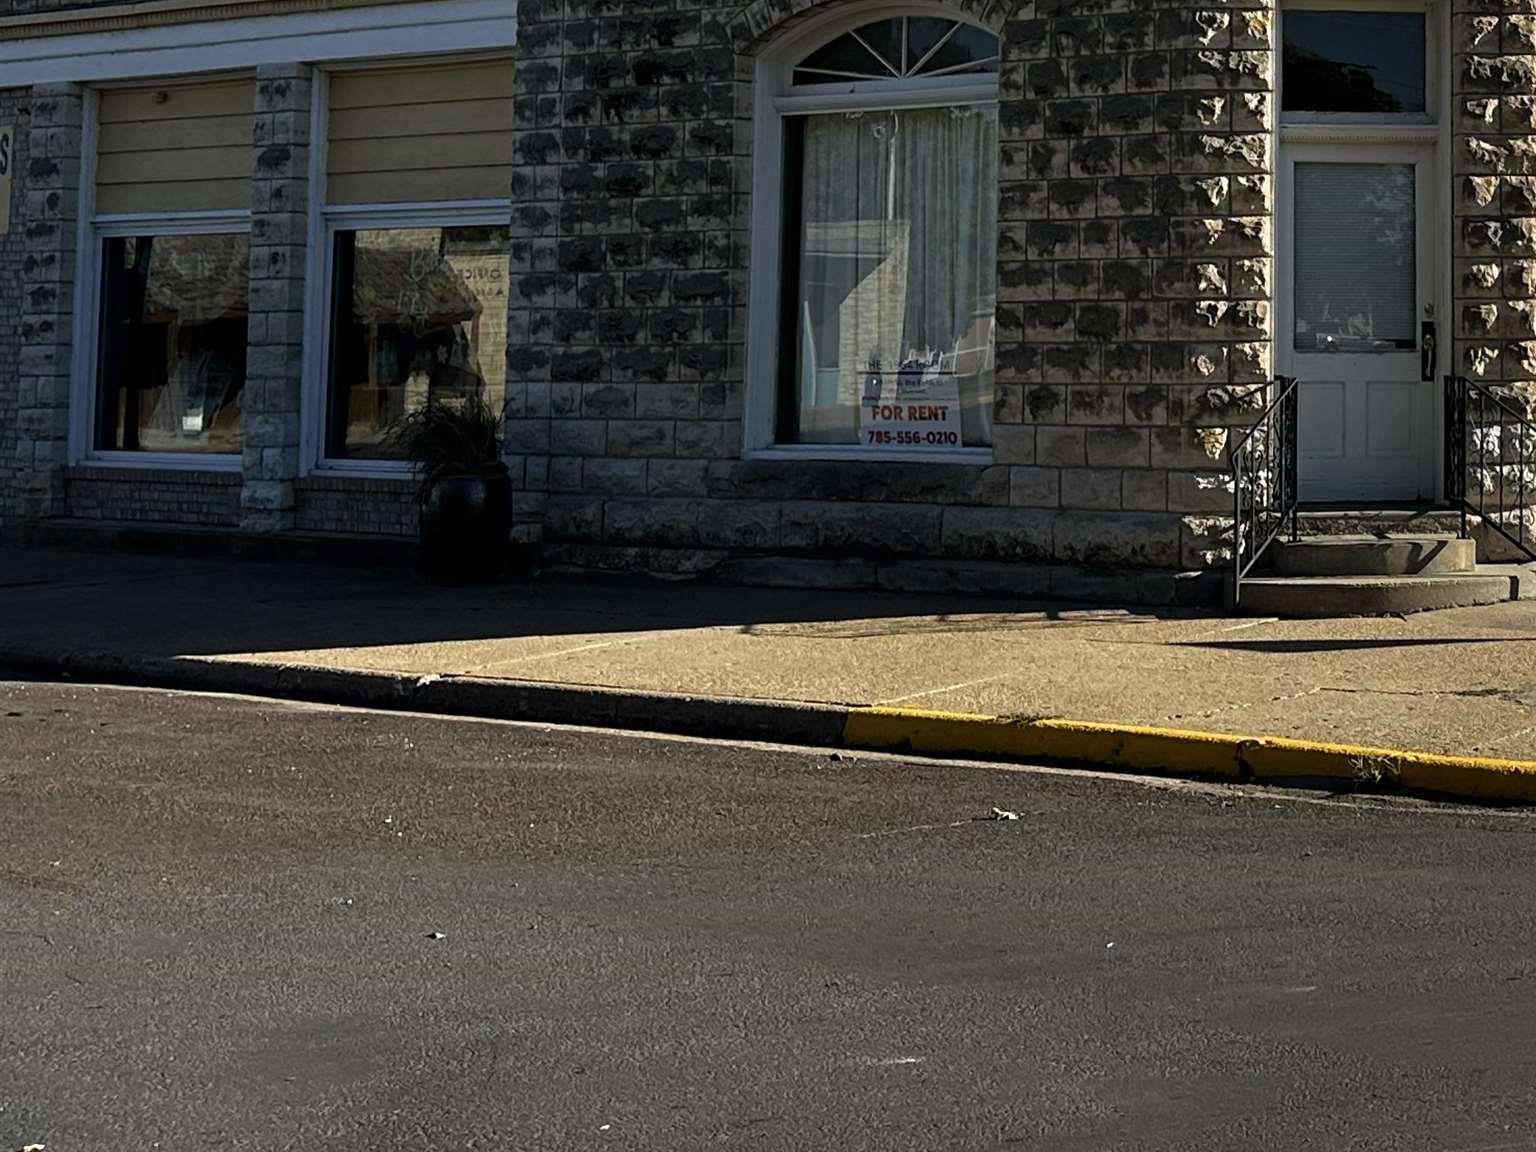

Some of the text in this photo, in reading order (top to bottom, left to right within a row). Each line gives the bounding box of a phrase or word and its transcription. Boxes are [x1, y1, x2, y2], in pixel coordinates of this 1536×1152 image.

[871, 405, 949, 421] FOR RENT
[868, 430, 958, 445] 785-556-0210
